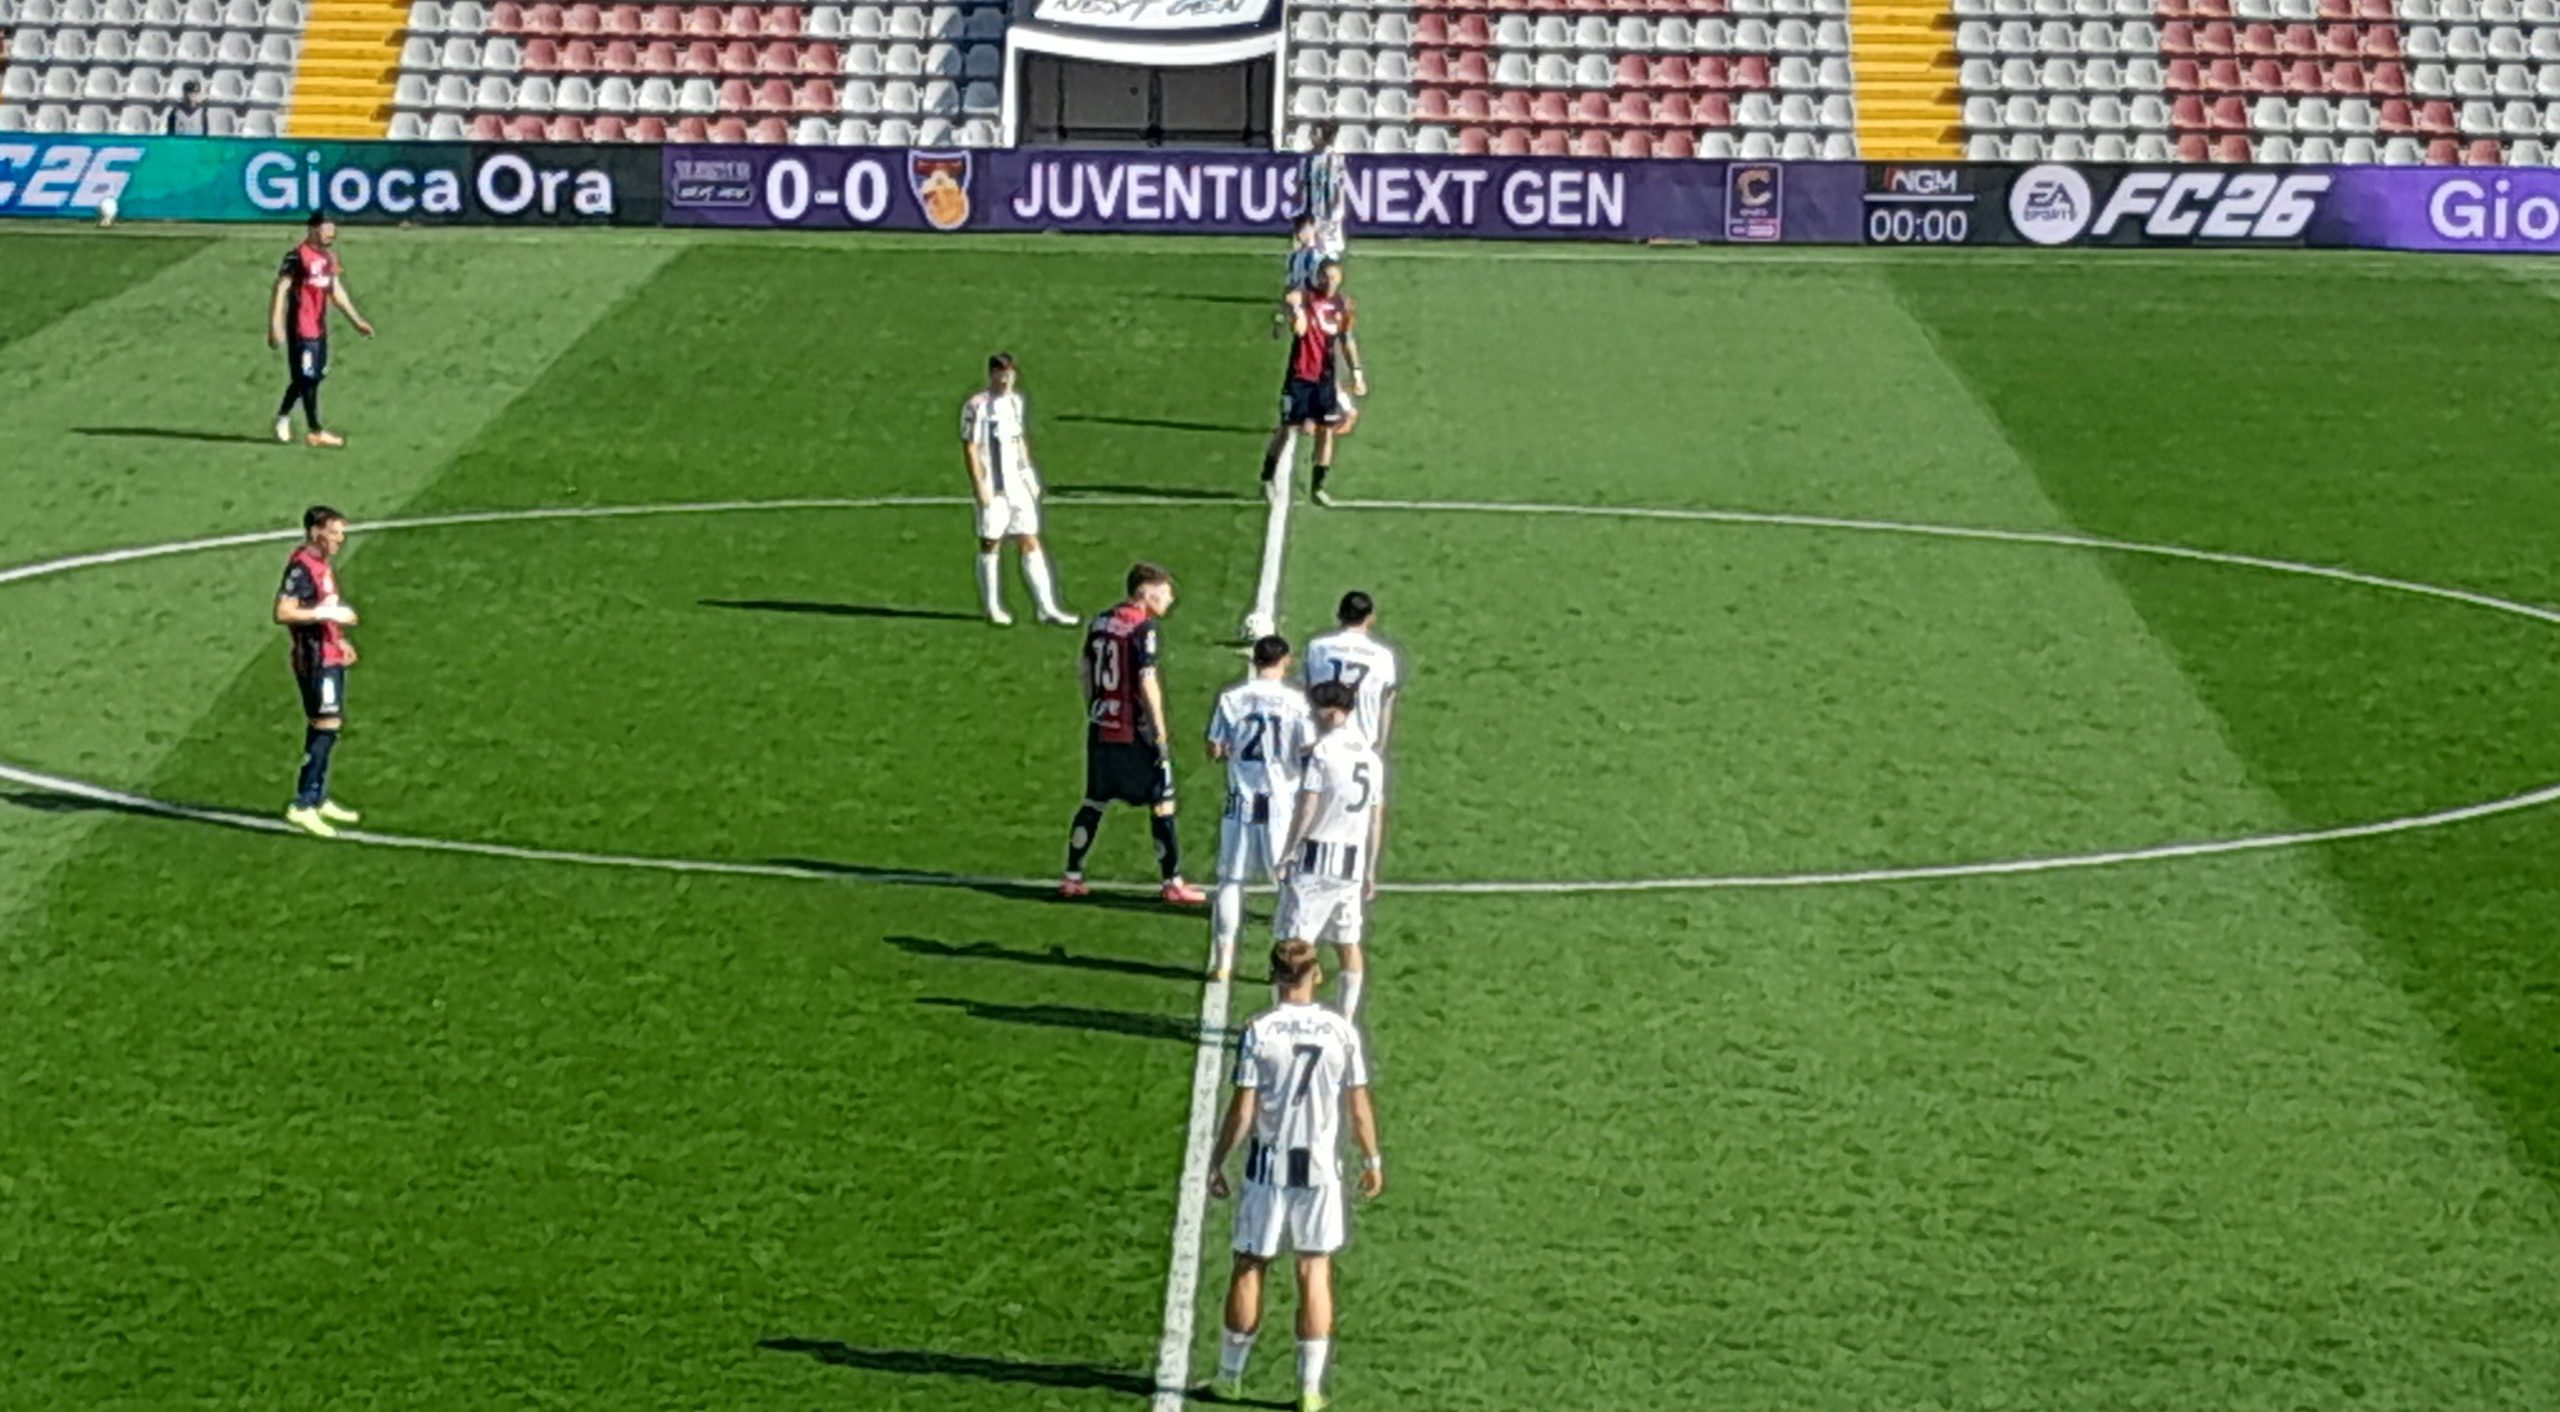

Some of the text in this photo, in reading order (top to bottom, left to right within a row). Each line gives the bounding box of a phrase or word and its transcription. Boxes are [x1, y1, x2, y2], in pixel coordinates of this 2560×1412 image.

[244, 151, 615, 214] Gioca Ora
[765, 159, 889, 223] 0-0
[1343, 168, 1487, 224] NEXT
[1502, 171, 1625, 226] GEN
[2028, 180, 2075, 208] EA
[2429, 179, 2560, 240] Gio
[1869, 209, 1969, 243] 00:00
[1092, 637, 1121, 692] 13
[1241, 713, 1283, 762] 21
[1345, 761, 1371, 814] 5
[1291, 1042, 1325, 1107] 7
